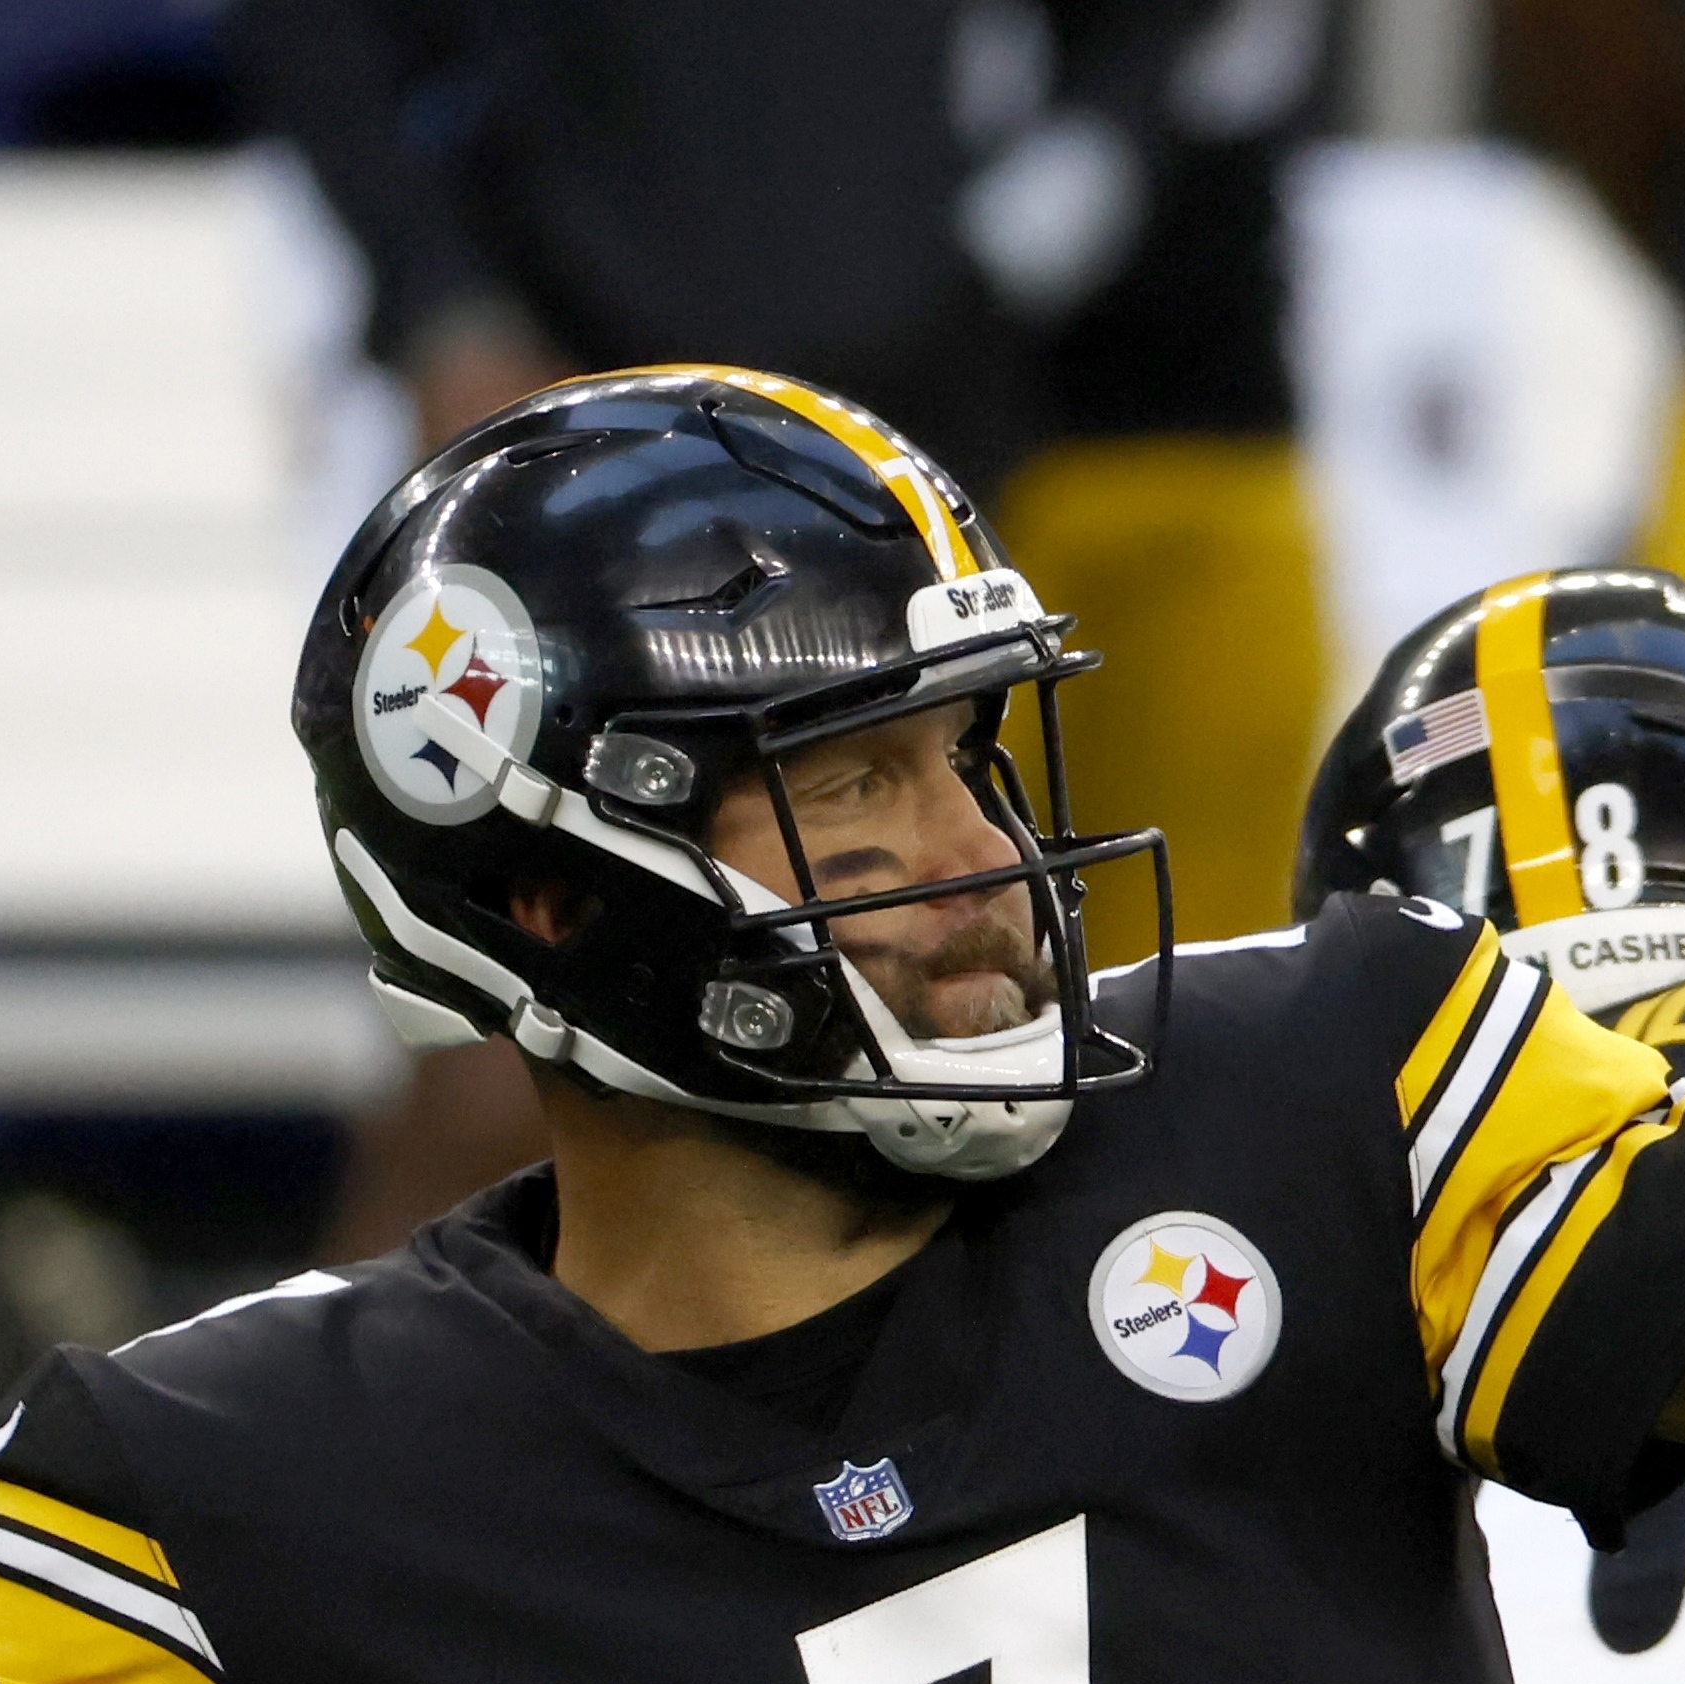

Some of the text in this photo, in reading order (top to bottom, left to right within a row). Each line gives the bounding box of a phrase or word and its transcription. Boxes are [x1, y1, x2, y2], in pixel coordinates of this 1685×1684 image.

[876, 456, 957, 583] 7
[1113, 1299, 1183, 1339] Steelers
[838, 1491, 899, 1529] NFL
